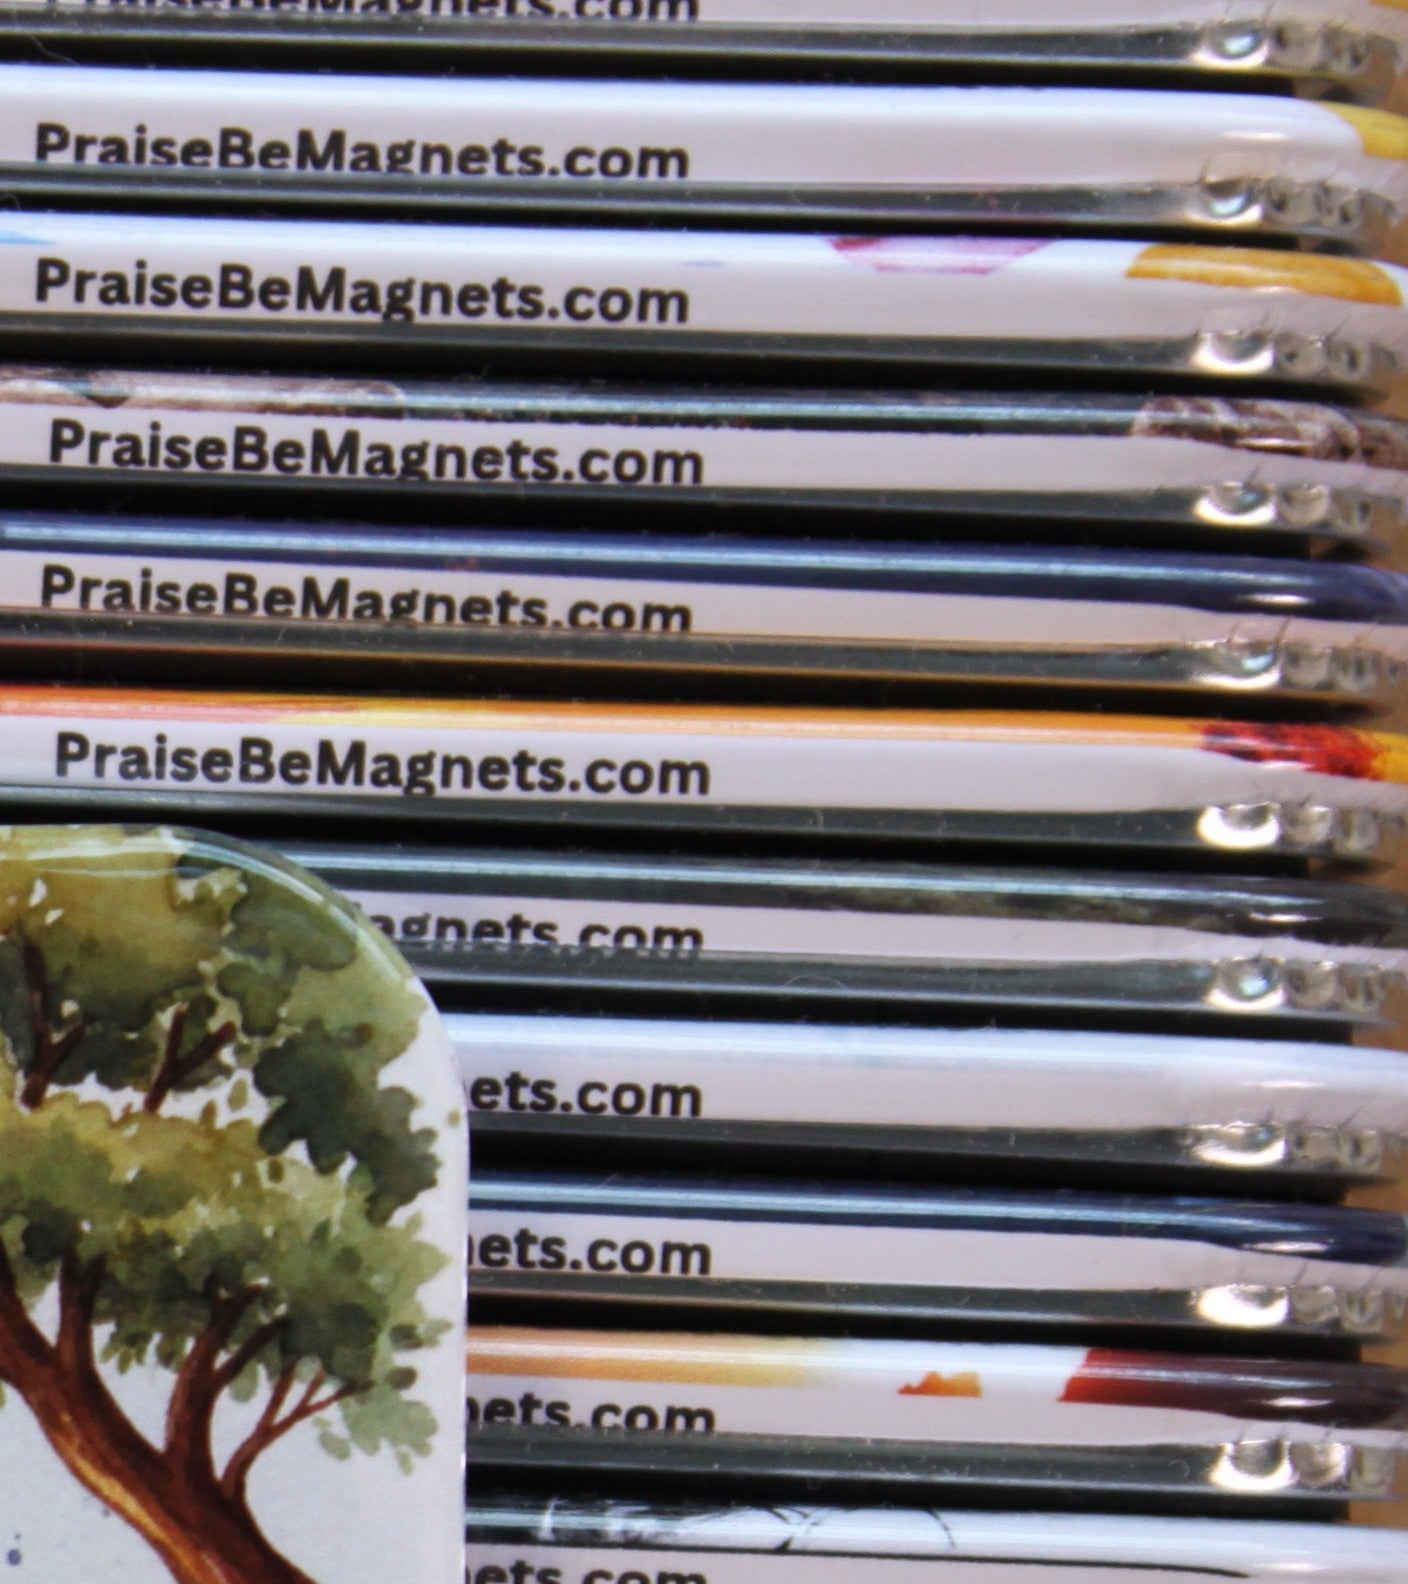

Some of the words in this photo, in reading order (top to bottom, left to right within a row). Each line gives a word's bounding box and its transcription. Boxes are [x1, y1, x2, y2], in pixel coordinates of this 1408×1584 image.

[36, 122, 689, 178] PraiseBeMagnets.com
[36, 258, 689, 323] PraiseBeMagnets.com
[49, 418, 704, 485] PraiseBeMagnets.com
[41, 564, 692, 632] PraiseBeMagnets.com
[55, 731, 710, 796] PraiseBeMagnets.com
